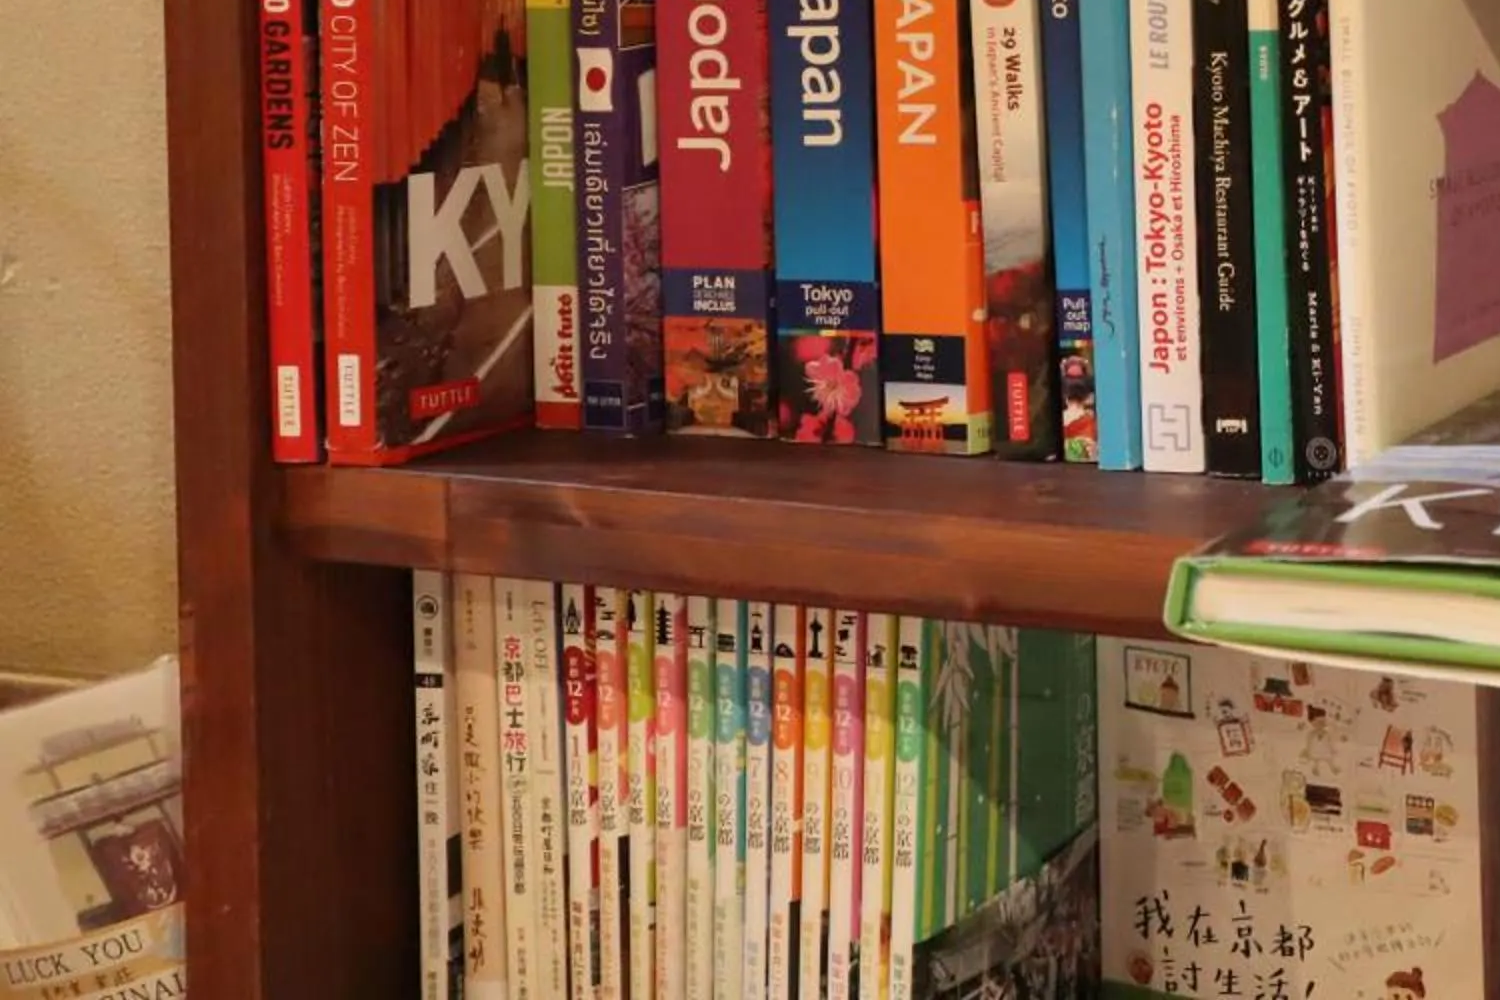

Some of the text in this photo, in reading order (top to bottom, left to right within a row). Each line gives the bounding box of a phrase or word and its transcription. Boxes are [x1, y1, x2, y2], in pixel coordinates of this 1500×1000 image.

[330, 13, 358, 74] CITY
[1000, 26, 1024, 113] 29 Walks
[1149, 50, 1170, 71] LE
[264, 20, 295, 150] GARDENS
[331, 82, 358, 119] OF
[332, 124, 359, 183] ZEN
[541, 106, 574, 192] JAPON
[1169, 114, 1184, 194] Hiroshima
[1143, 102, 1171, 274] Tokyo-Kyoto
[1208, 51, 1235, 311] Kyoto Machiya Restaurant Guide
[1171, 224, 1185, 262] Osaka
[692, 275, 736, 289] PLAN
[692, 300, 737, 312] INCLUS
[800, 283, 854, 306] Tokyo
[815, 315, 842, 327] map
[1063, 320, 1091, 334] map
[1148, 290, 1171, 374] Japon
[1174, 280, 1186, 347] environs
[419, 387, 473, 411] TUTTLE
[1010, 379, 1025, 435] TUTTLE
[502, 636, 525, 773] 京都巴士旅行
[1135, 889, 1316, 962] 我在京都
[4, 928, 144, 986] LUCK YOU
